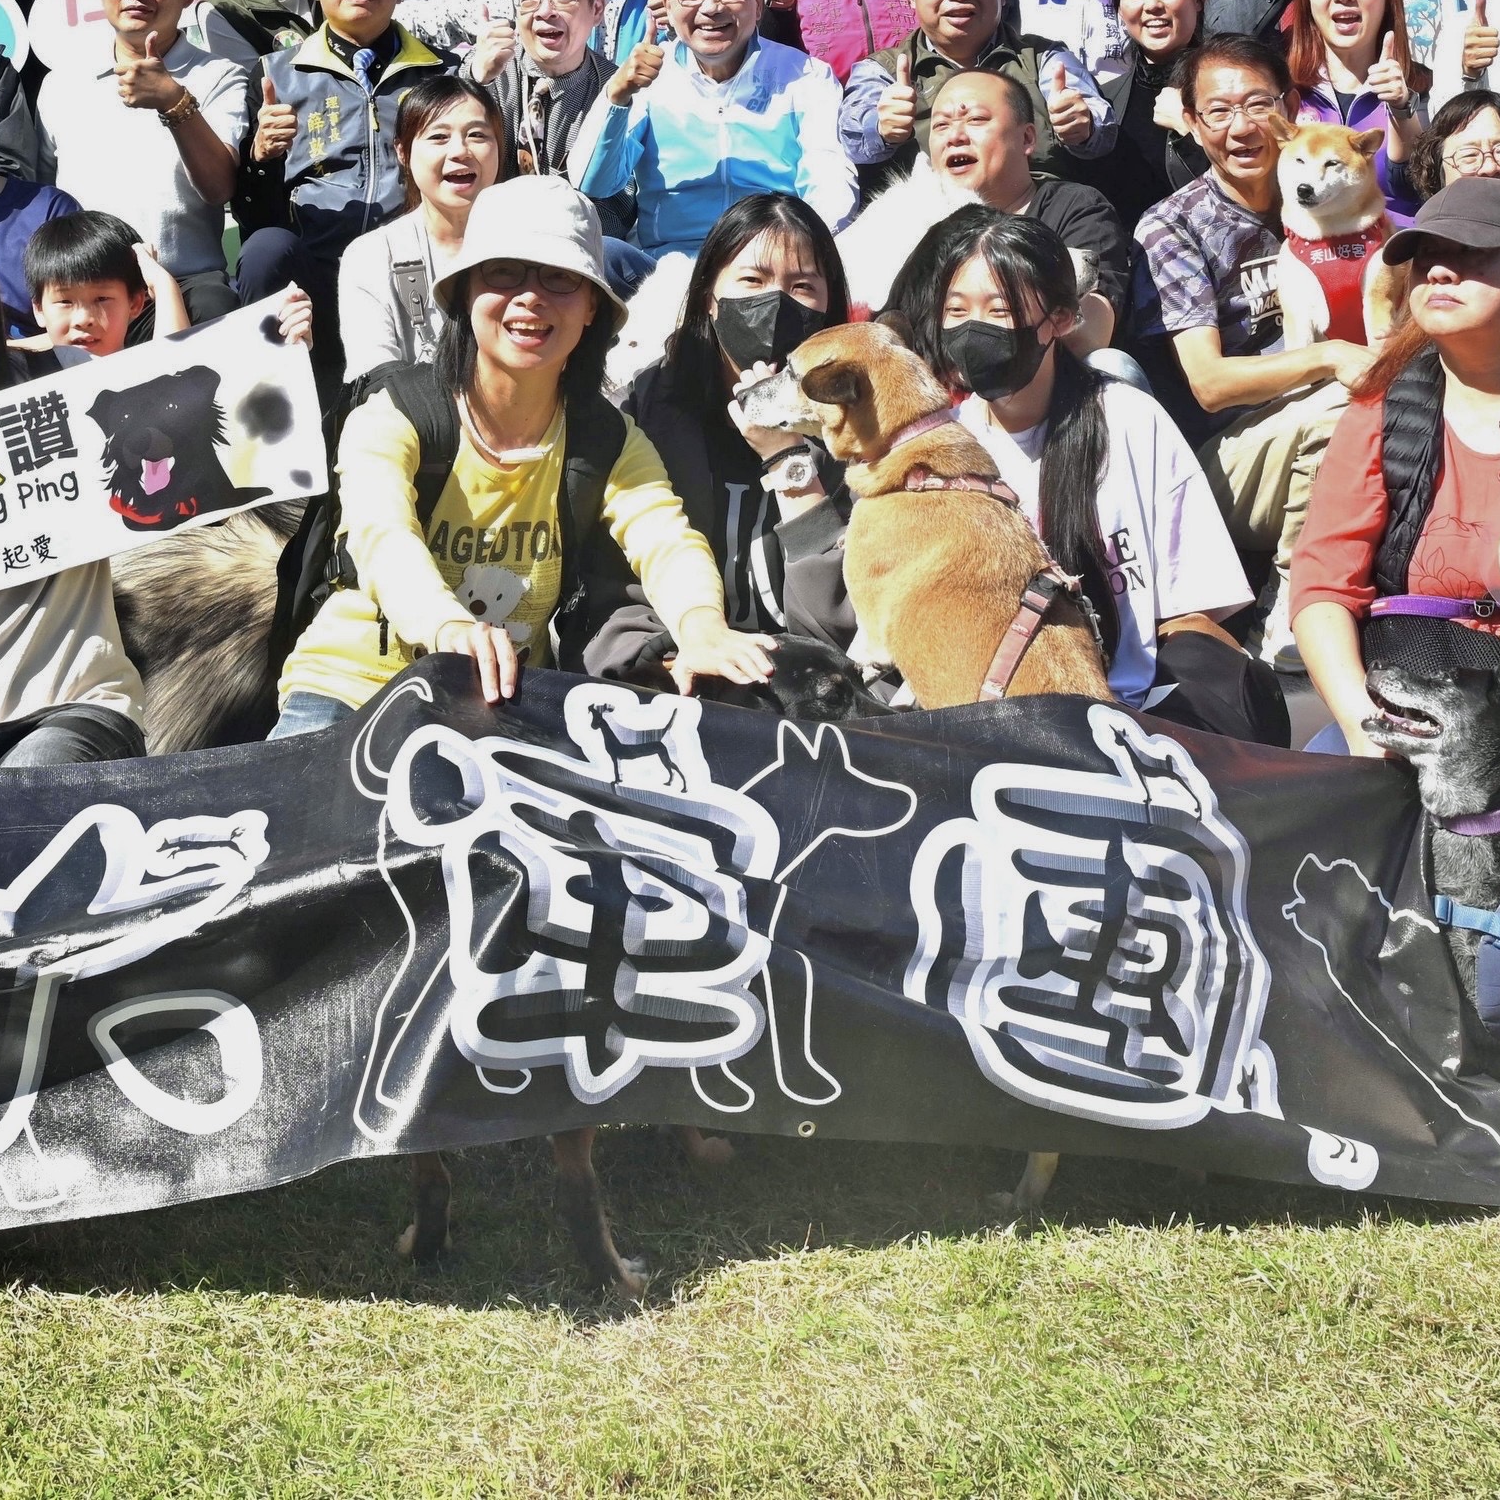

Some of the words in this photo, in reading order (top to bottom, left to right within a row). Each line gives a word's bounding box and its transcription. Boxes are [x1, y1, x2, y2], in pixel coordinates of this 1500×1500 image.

[1310, 244, 1366, 265] 秀山好客
[18, 470, 79, 510] Ping
